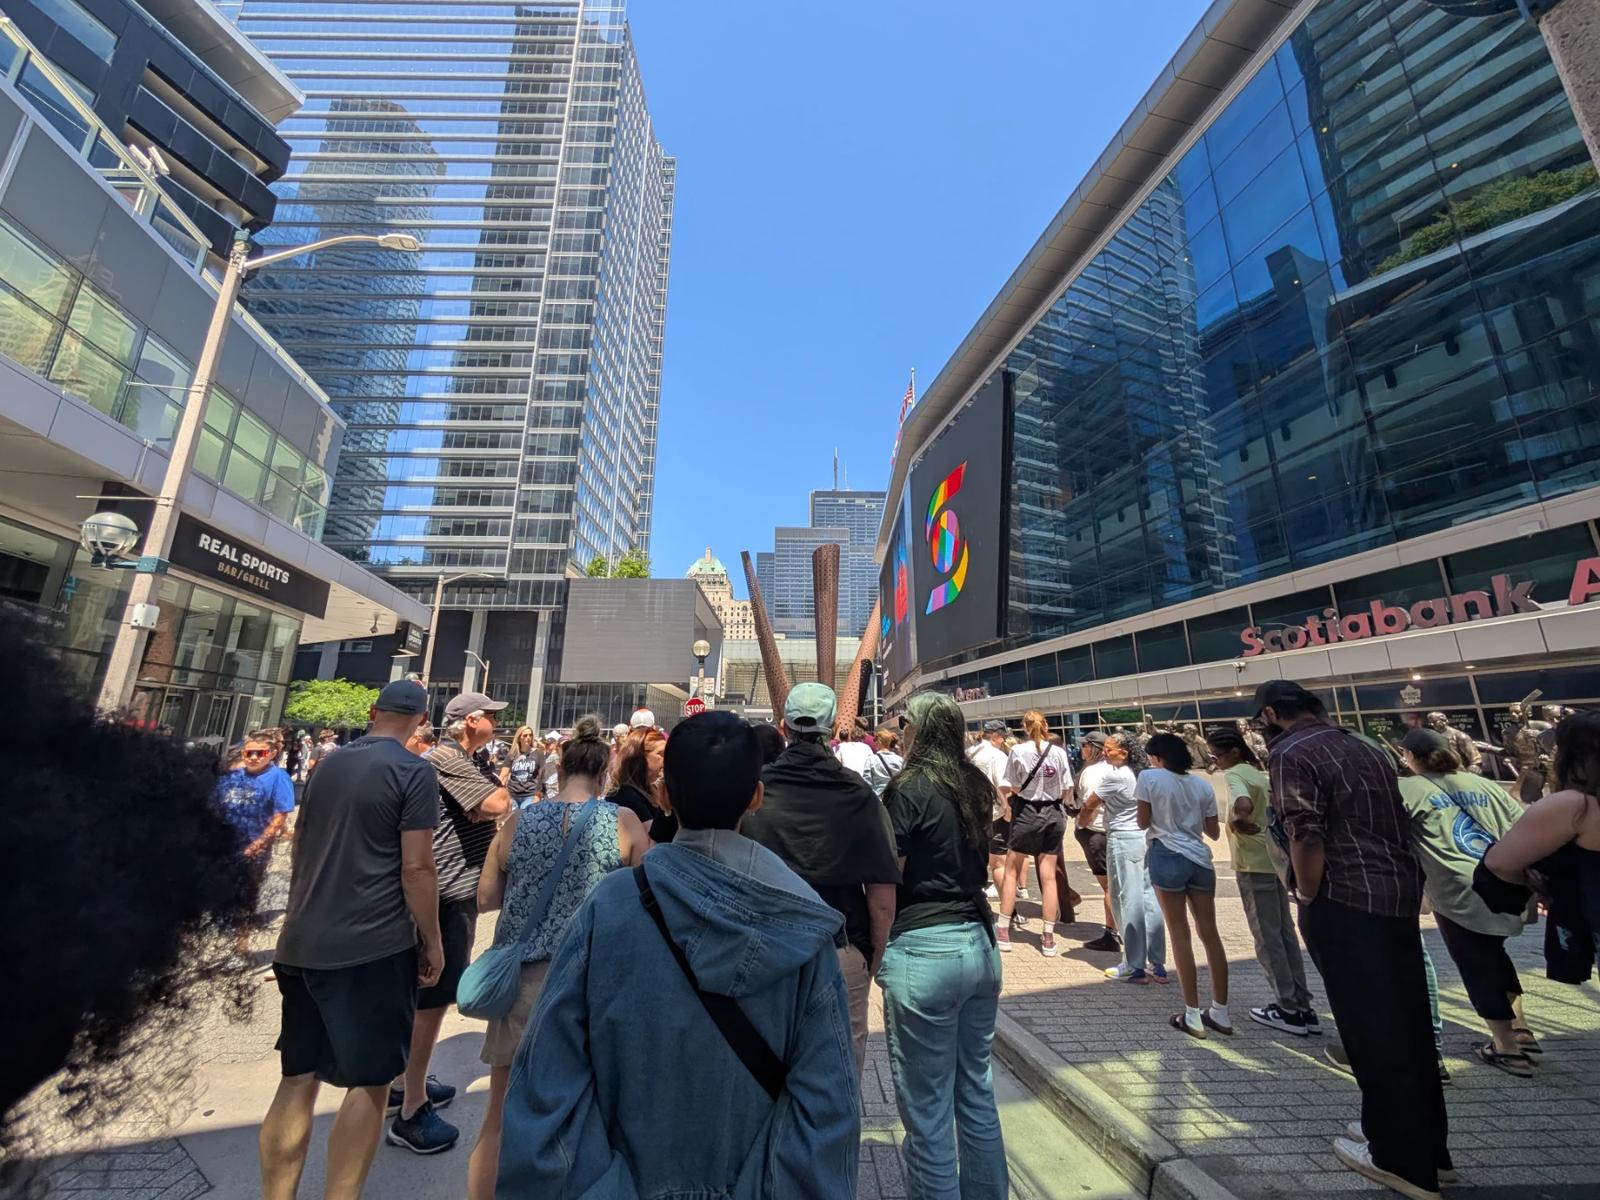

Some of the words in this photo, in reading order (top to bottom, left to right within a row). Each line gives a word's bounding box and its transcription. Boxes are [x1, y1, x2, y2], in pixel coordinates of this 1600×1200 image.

[199, 533, 239, 562] REAL
[241, 553, 290, 584] SPORTS
[217, 562, 270, 590] BAR/GRILL
[1239, 574, 1543, 657] Scotiabank
[686, 704, 705, 715] STOP
